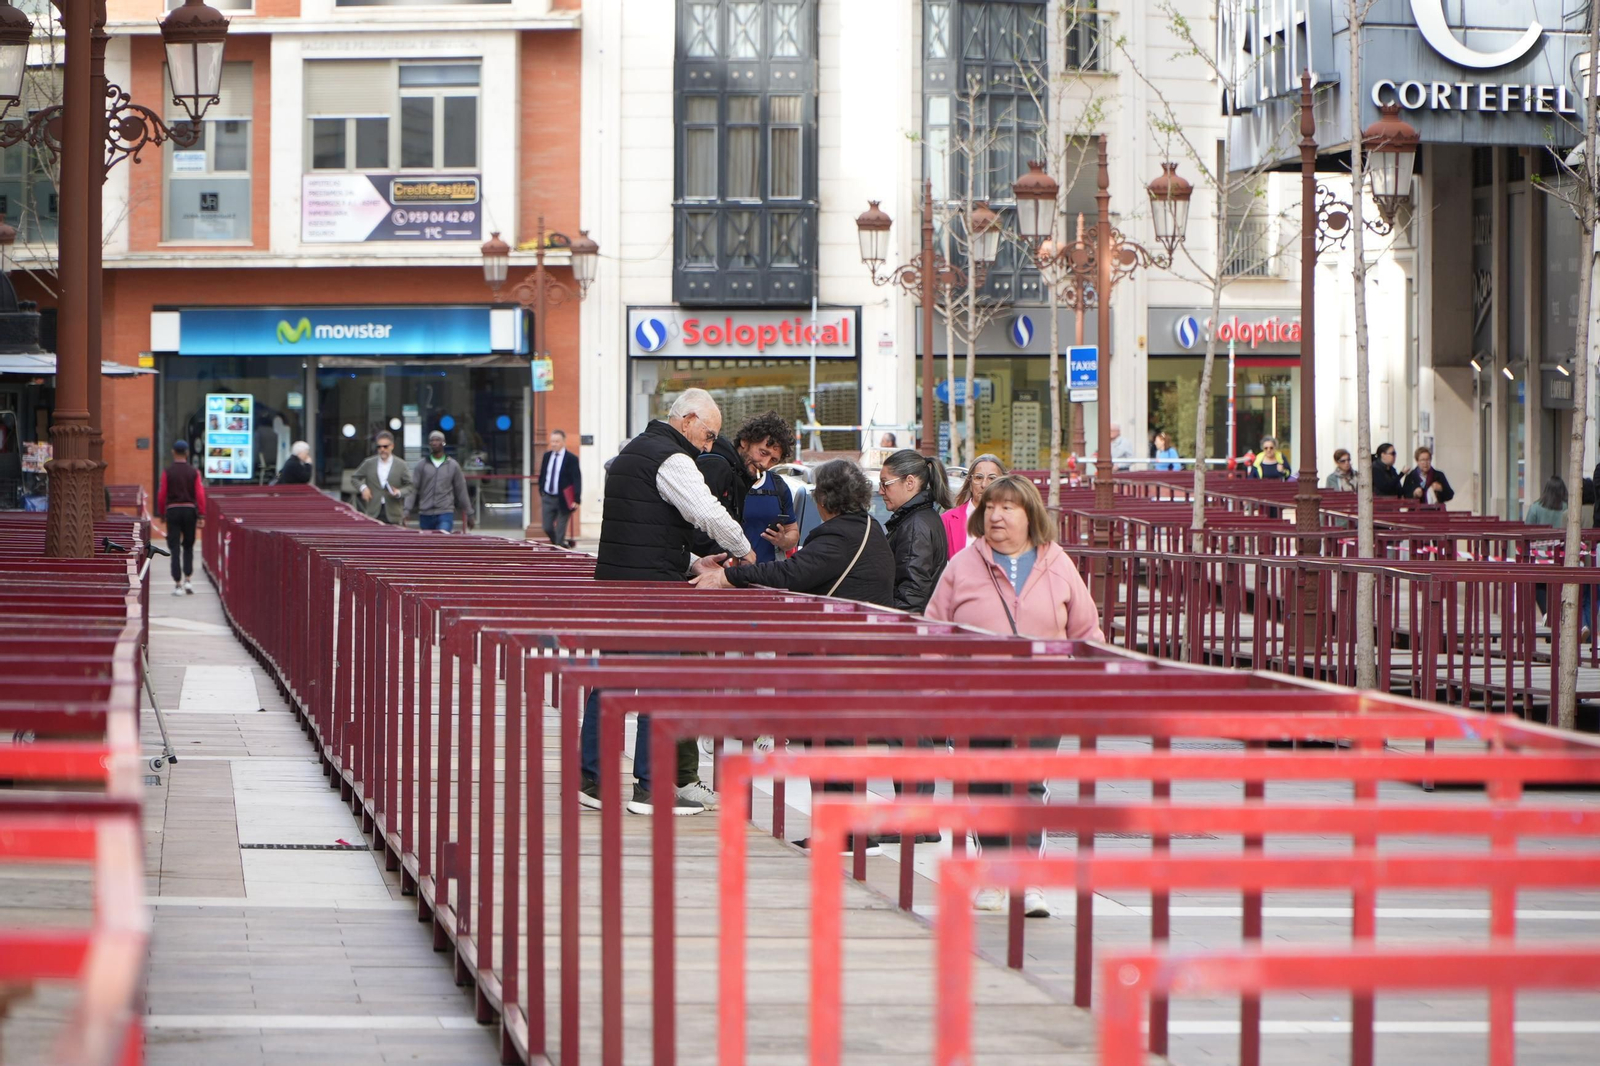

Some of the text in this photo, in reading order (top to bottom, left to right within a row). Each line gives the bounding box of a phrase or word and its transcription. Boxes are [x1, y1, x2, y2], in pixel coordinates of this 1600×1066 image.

[1371, 79, 1576, 114] CORTEFIEL
[394, 182, 477, 195] CreditGestión
[408, 210, 476, 223] 959 04 42 49
[315, 323, 393, 339] movistar
[682, 317, 849, 352] Soloptical
[1071, 360, 1098, 371] TAXIS
